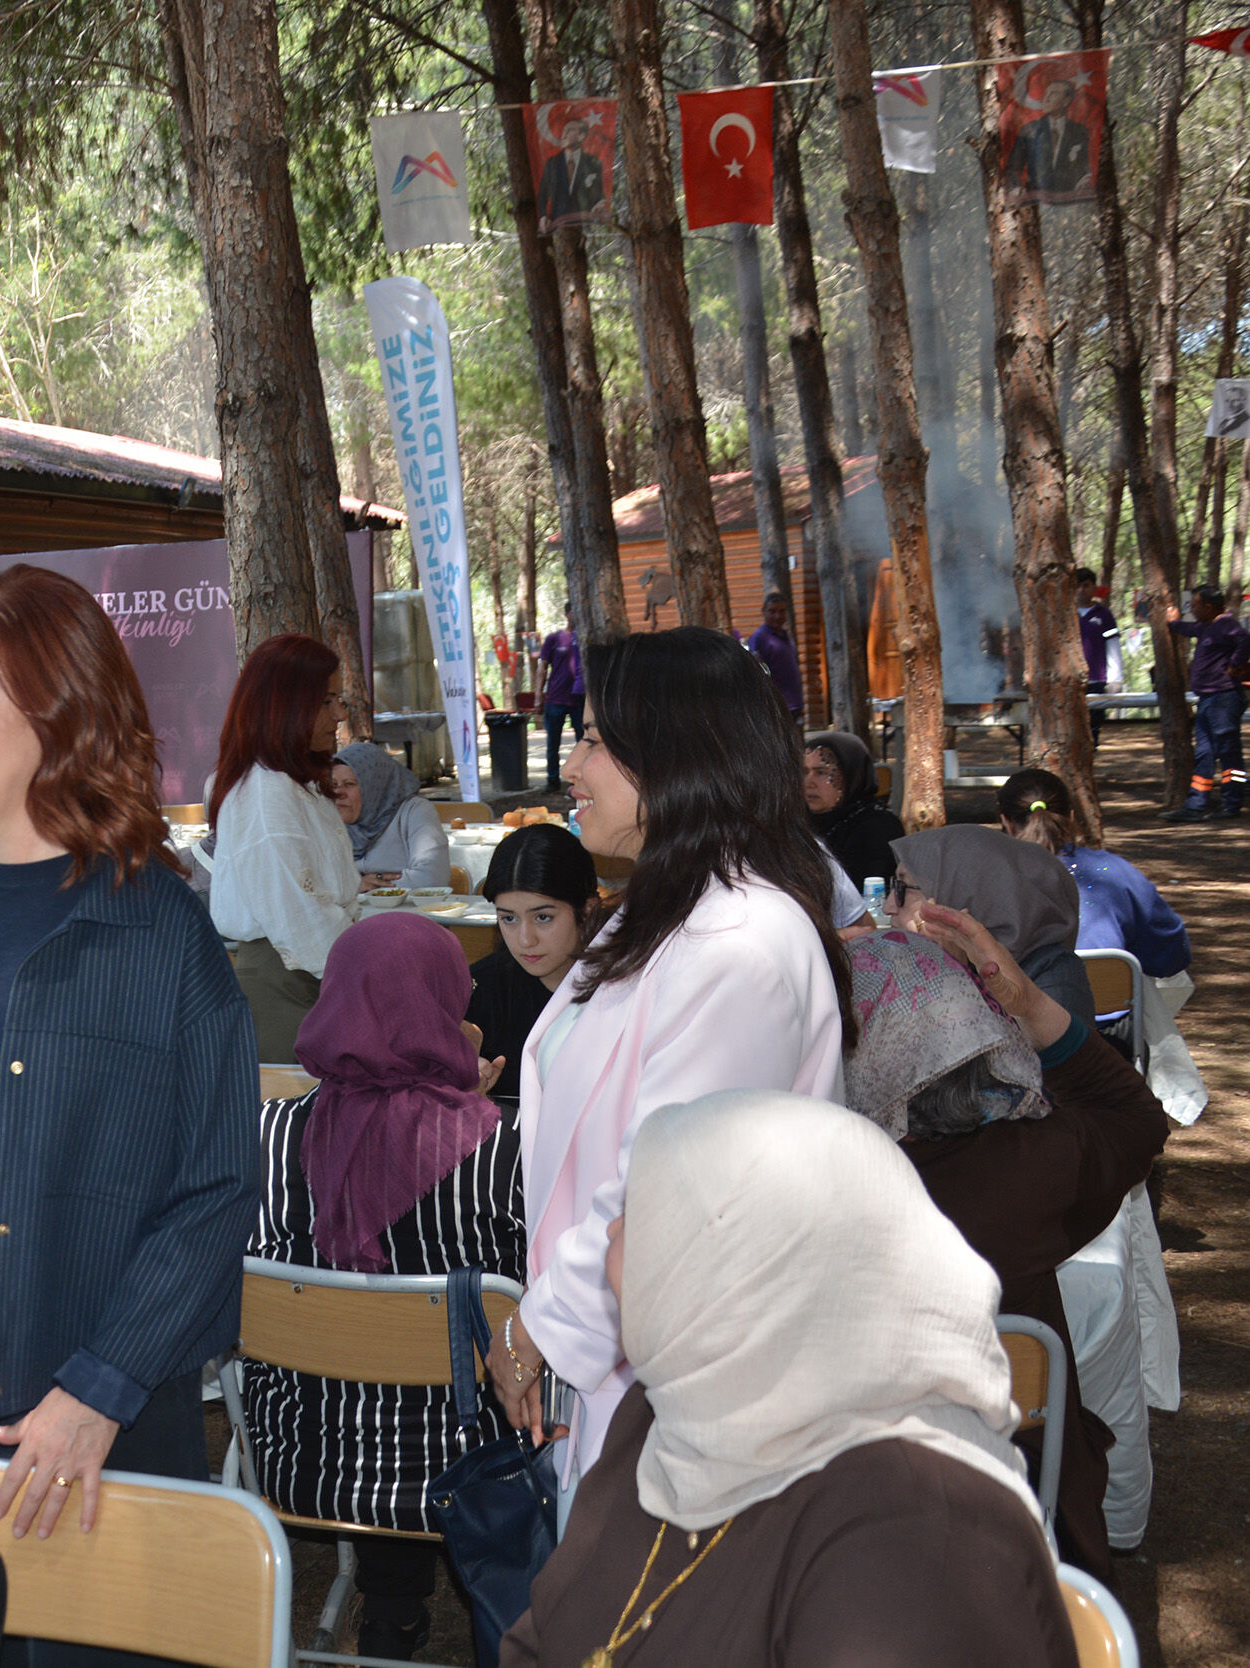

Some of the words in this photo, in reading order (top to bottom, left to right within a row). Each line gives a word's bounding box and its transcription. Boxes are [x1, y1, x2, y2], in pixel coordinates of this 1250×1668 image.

[93, 589, 168, 615] ELER
[173, 579, 232, 612] GÜN
[113, 609, 196, 648] tkinliği
